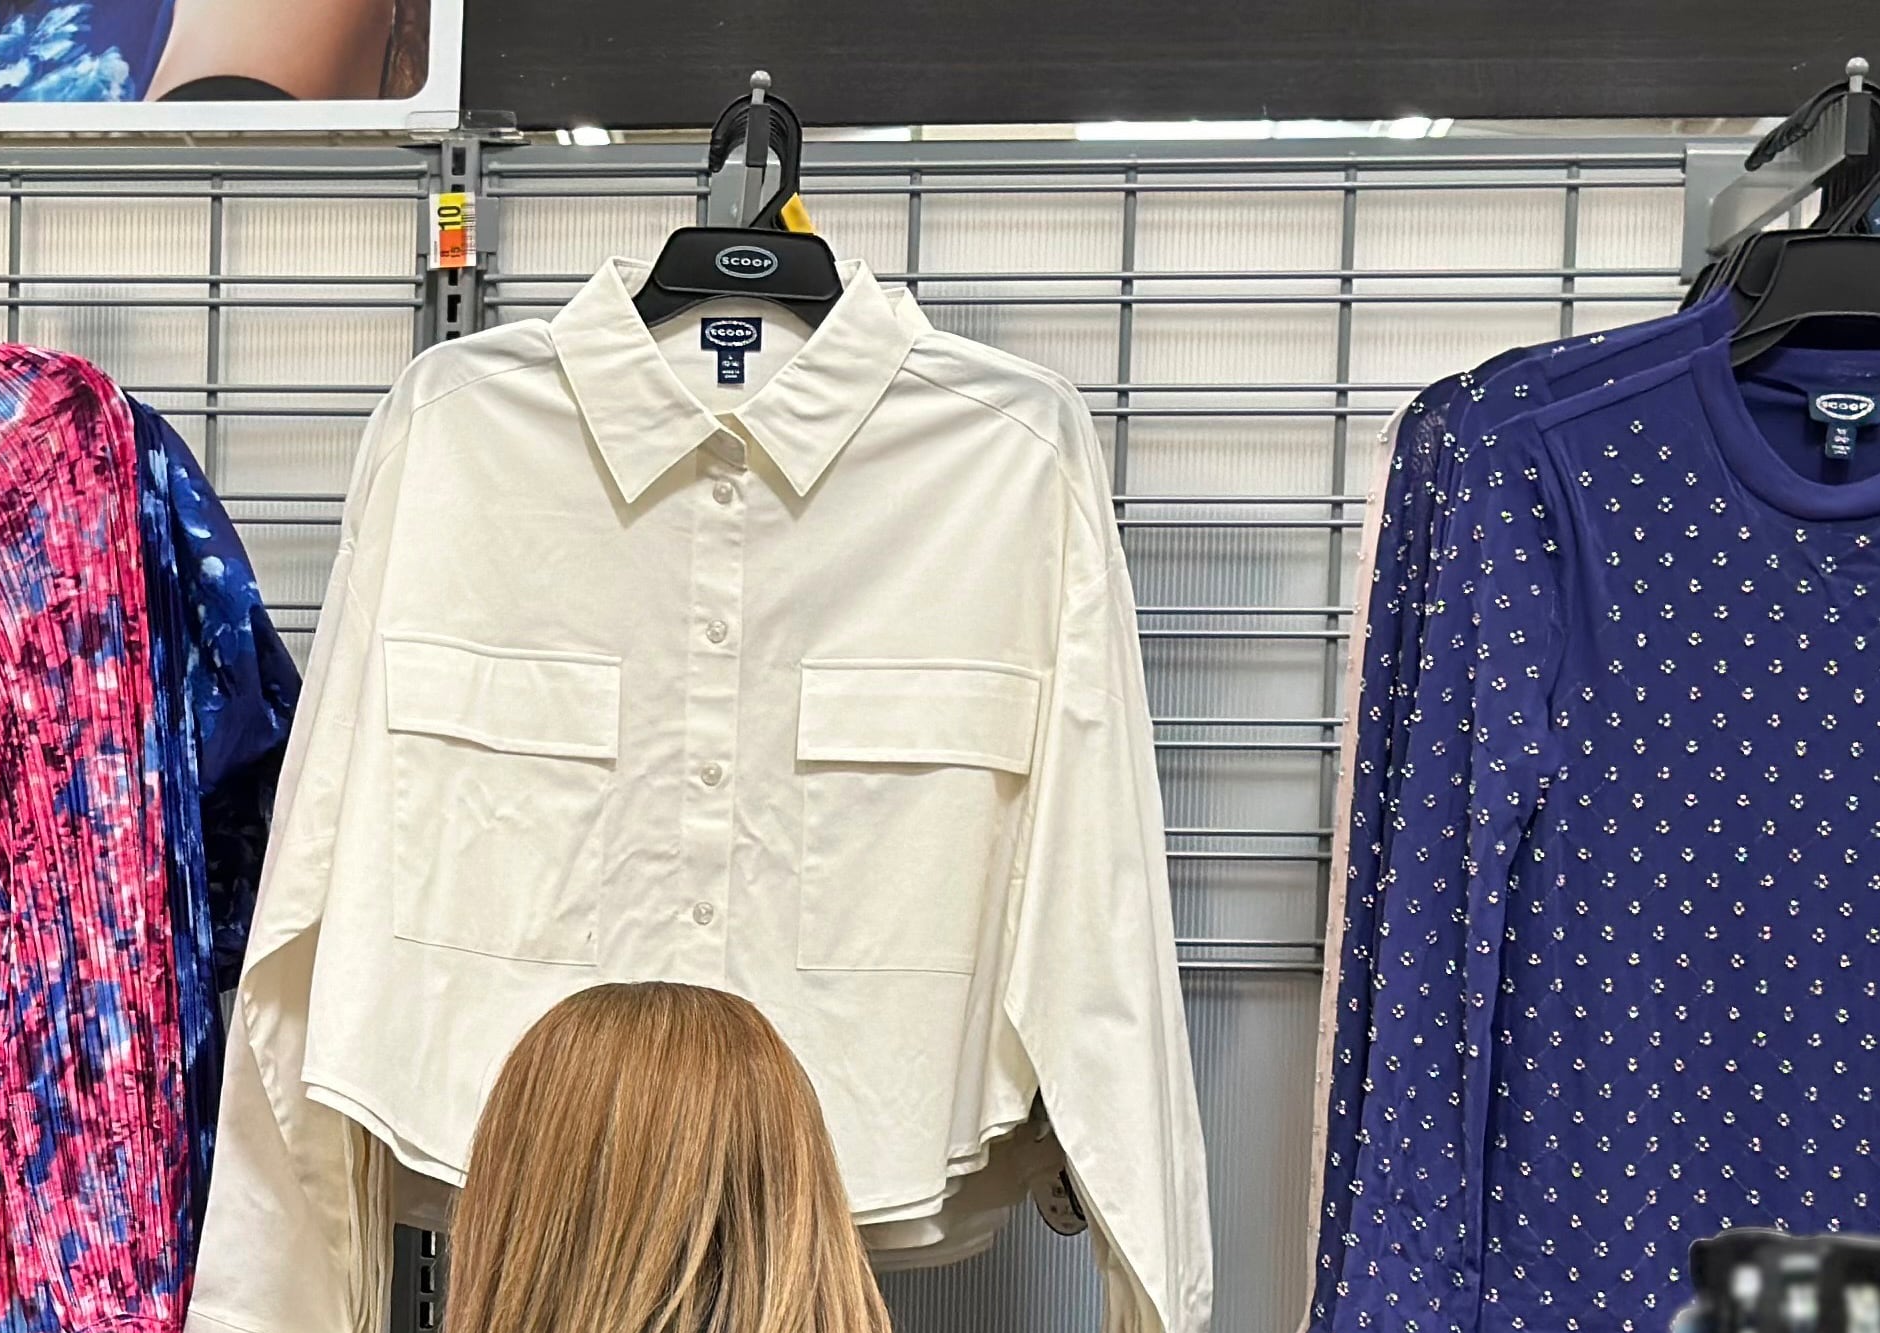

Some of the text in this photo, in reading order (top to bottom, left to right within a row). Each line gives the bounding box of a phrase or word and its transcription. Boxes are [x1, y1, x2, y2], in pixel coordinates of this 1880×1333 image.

[437, 206, 461, 231] 10
[722, 256, 772, 268] SCOOP
[710, 328, 752, 337] SCOOP
[1821, 401, 1868, 411] SCOOP
